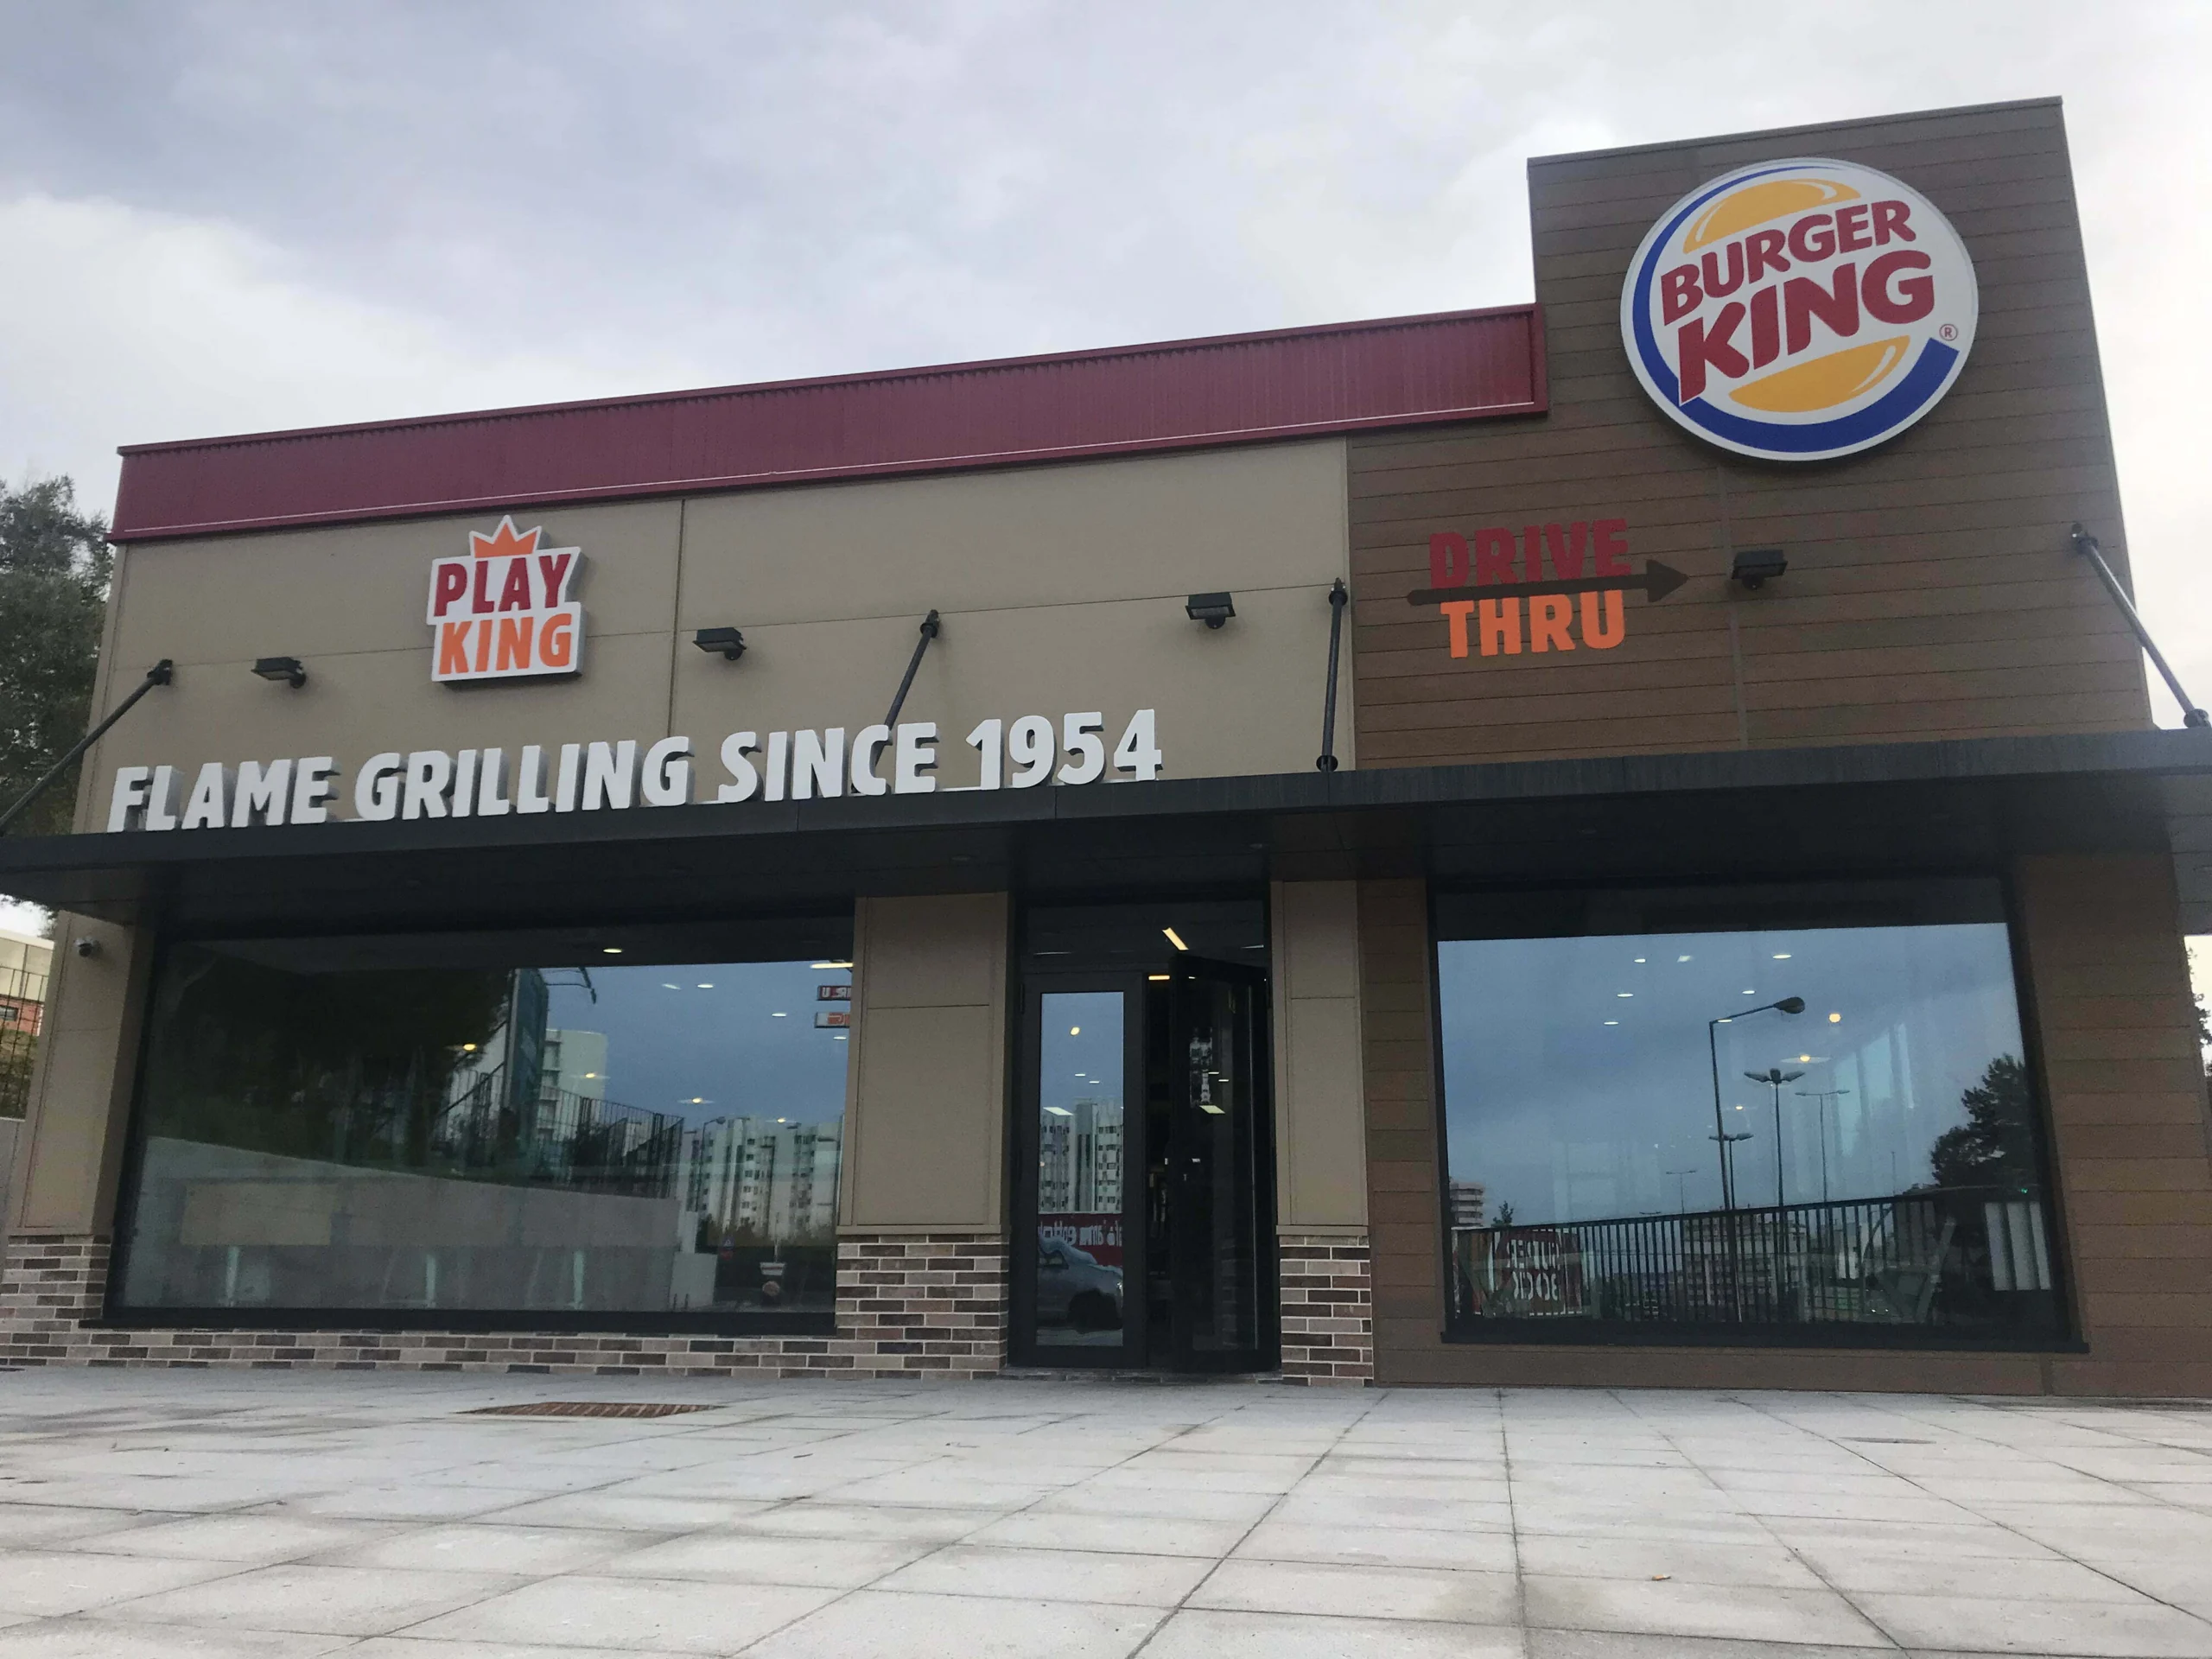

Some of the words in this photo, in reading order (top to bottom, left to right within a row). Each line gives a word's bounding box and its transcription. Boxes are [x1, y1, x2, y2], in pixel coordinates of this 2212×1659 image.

[1660, 200, 1916, 327] BURGER
[1677, 250, 1936, 404] KING
[433, 553, 572, 618] PLAY
[1428, 518, 1632, 590] DRIVE
[438, 613, 572, 676] KING
[1440, 589, 1626, 658] THRU
[106, 755, 337, 833] FLAME
[354, 735, 691, 821] GRILLING
[717, 722, 938, 804] SINCE
[965, 709, 1163, 792] 1954
